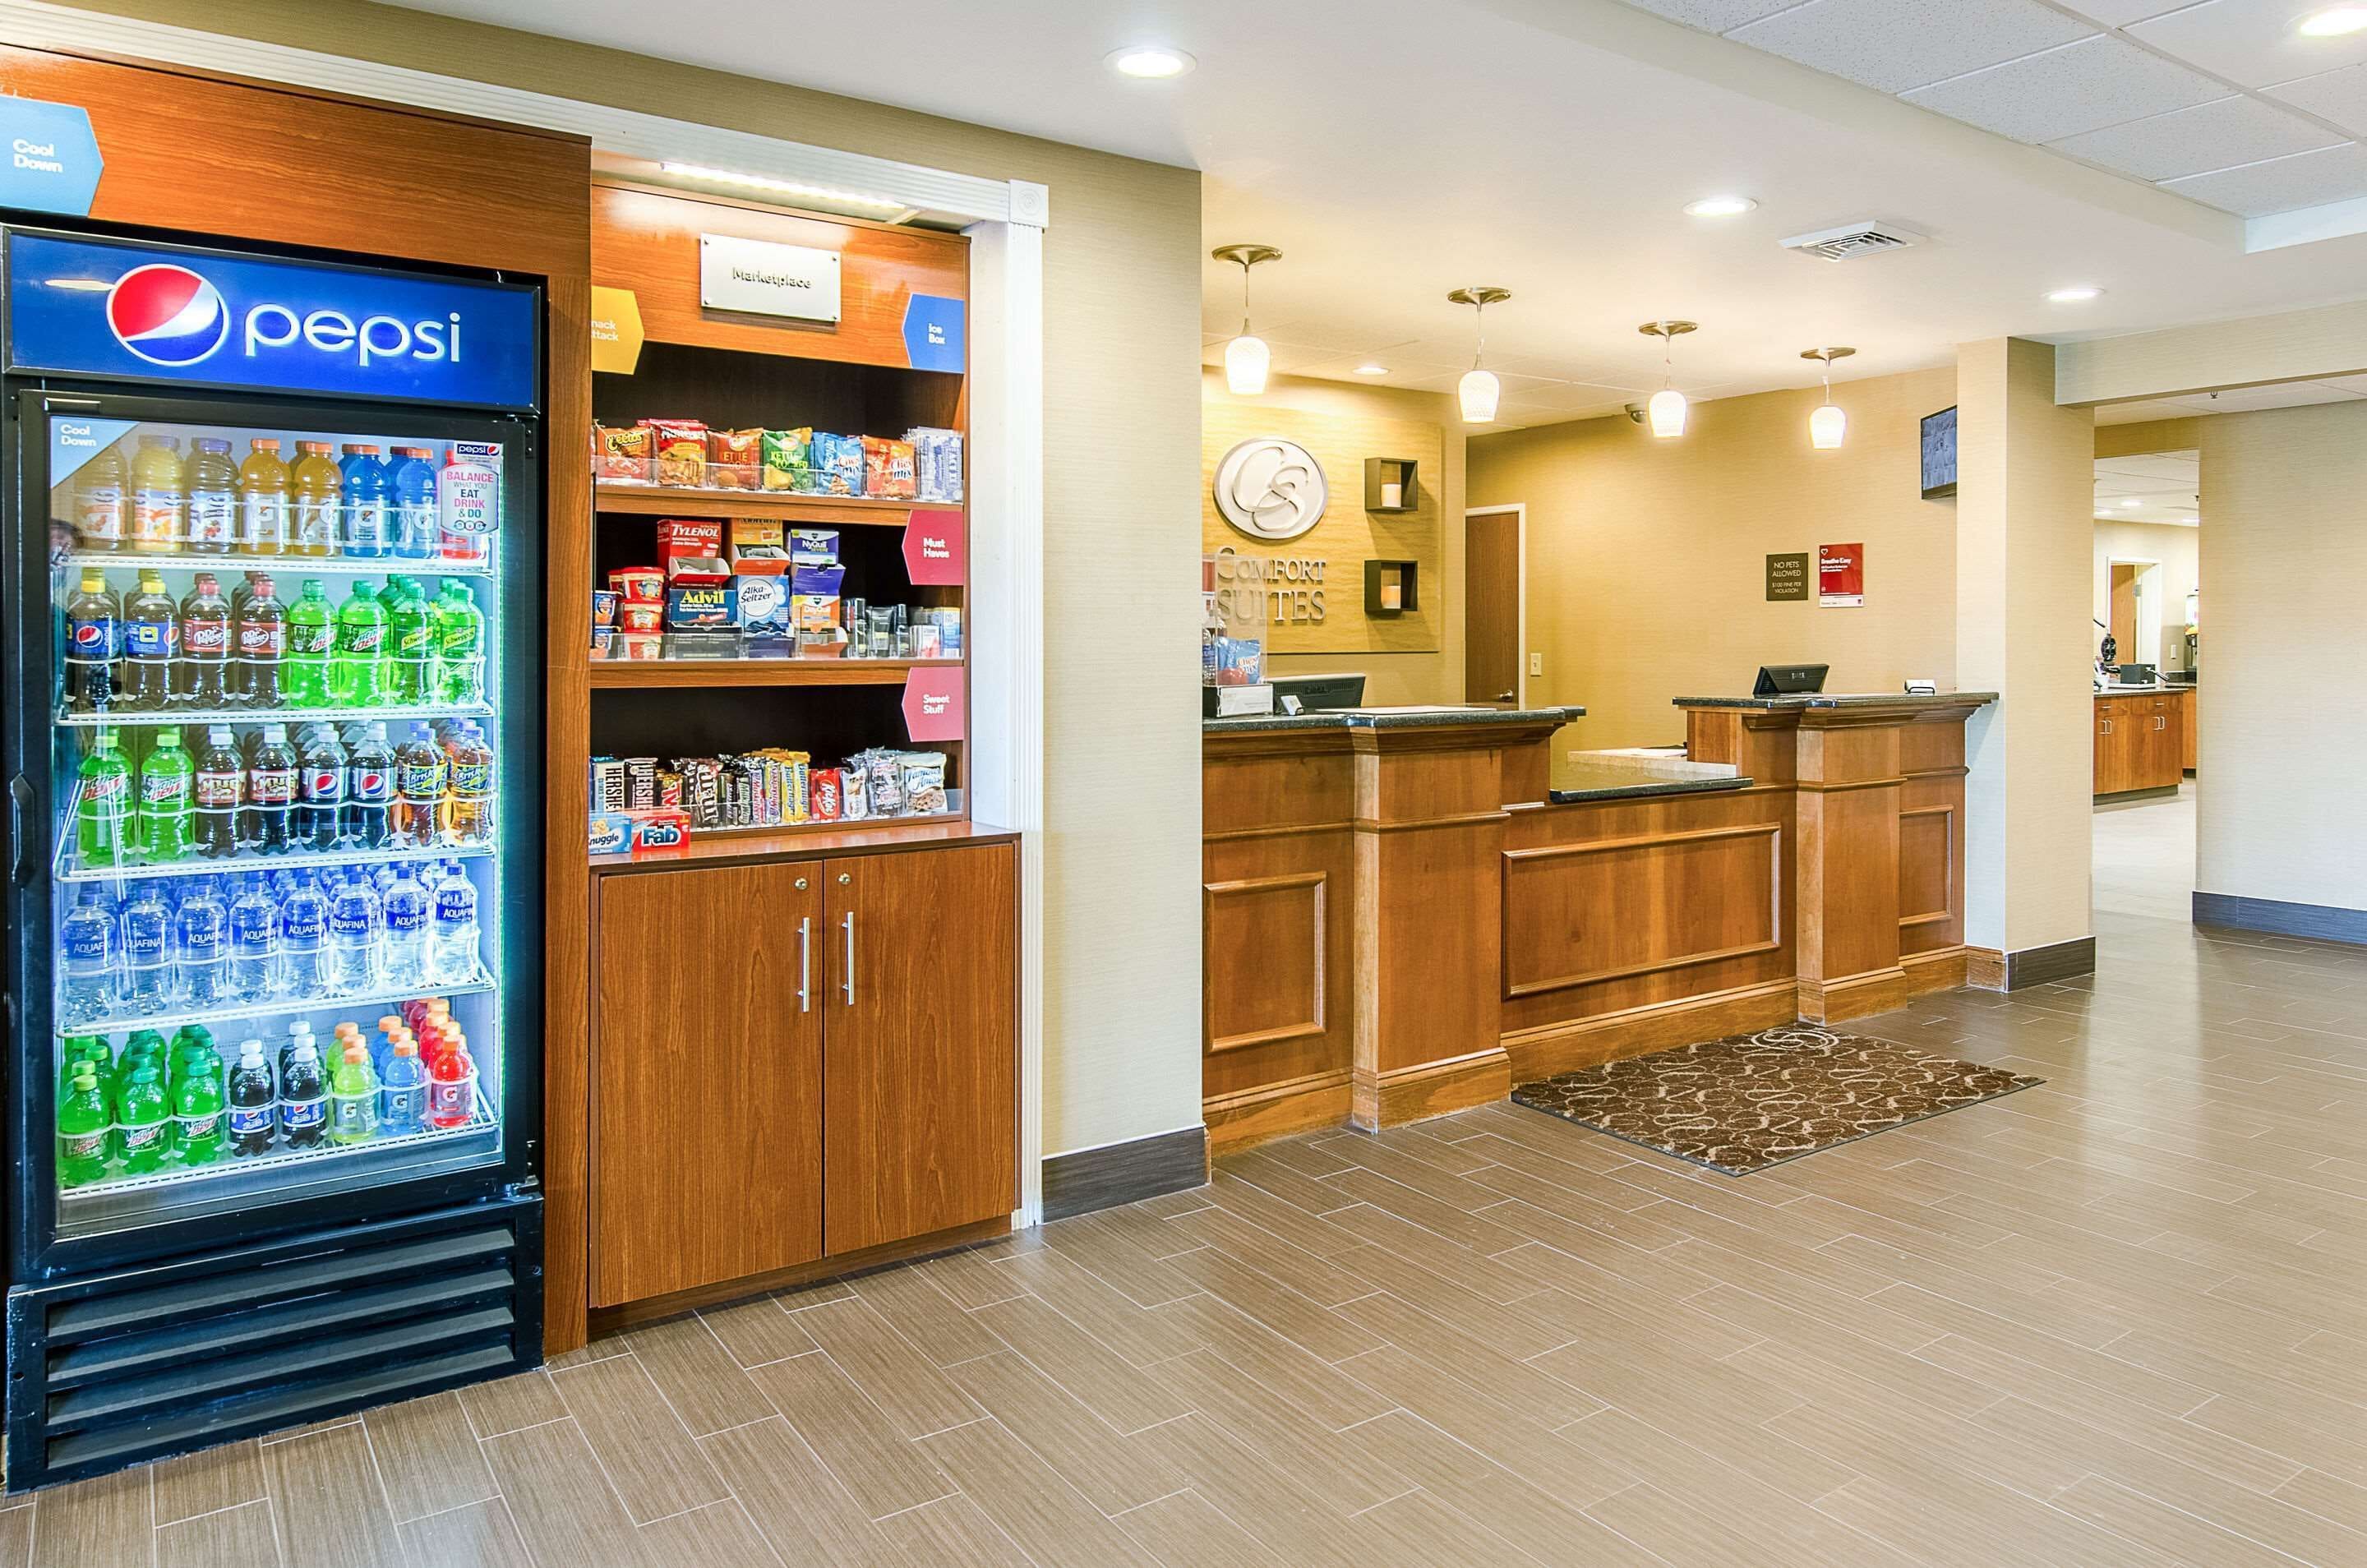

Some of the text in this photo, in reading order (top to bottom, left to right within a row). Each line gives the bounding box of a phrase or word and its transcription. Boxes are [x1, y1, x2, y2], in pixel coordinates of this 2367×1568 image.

[12, 137, 55, 158] Cool
[13, 152, 63, 173] Down
[731, 266, 812, 289] Marketplace
[591, 320, 616, 330] nack
[928, 323, 943, 334] Ice
[245, 302, 461, 367] pepsi
[591, 329, 618, 341] ttack
[928, 333, 945, 344] Box
[60, 424, 91, 436] Cool
[61, 436, 96, 447] Down
[459, 445, 486, 454] pepsi
[723, 451, 749, 461] ETLE
[446, 471, 494, 483] BALANCE
[460, 488, 479, 498] EAT
[454, 498, 485, 509] DRINK
[459, 508, 482, 518] & DO
[671, 523, 719, 537] TYLENOL
[923, 537, 946, 548] Must
[923, 547, 950, 558] Haves
[1217, 546, 1327, 584] COMFORT
[1772, 570, 1802, 578] ALLOWED
[744, 586, 768, 594] Alka-
[680, 590, 725, 604] Advil
[741, 592, 772, 603] Seltzer
[1216, 588, 1327, 624] SUITES
[922, 694, 950, 704] Sweet
[923, 704, 944, 715] Stuff
[606, 768, 623, 813] HERSHE
[636, 767, 654, 811] HERSHE
[589, 832, 619, 845] nuggle
[643, 826, 680, 846] Fab
[443, 907, 474, 920] AQUAFI
[394, 914, 428, 927] AQUAFIN
[242, 926, 278, 941] AQUAN
[288, 921, 327, 935] AQUAFIA
[187, 931, 223, 944] AQUAFN
[73, 941, 104, 954] AQUAF
